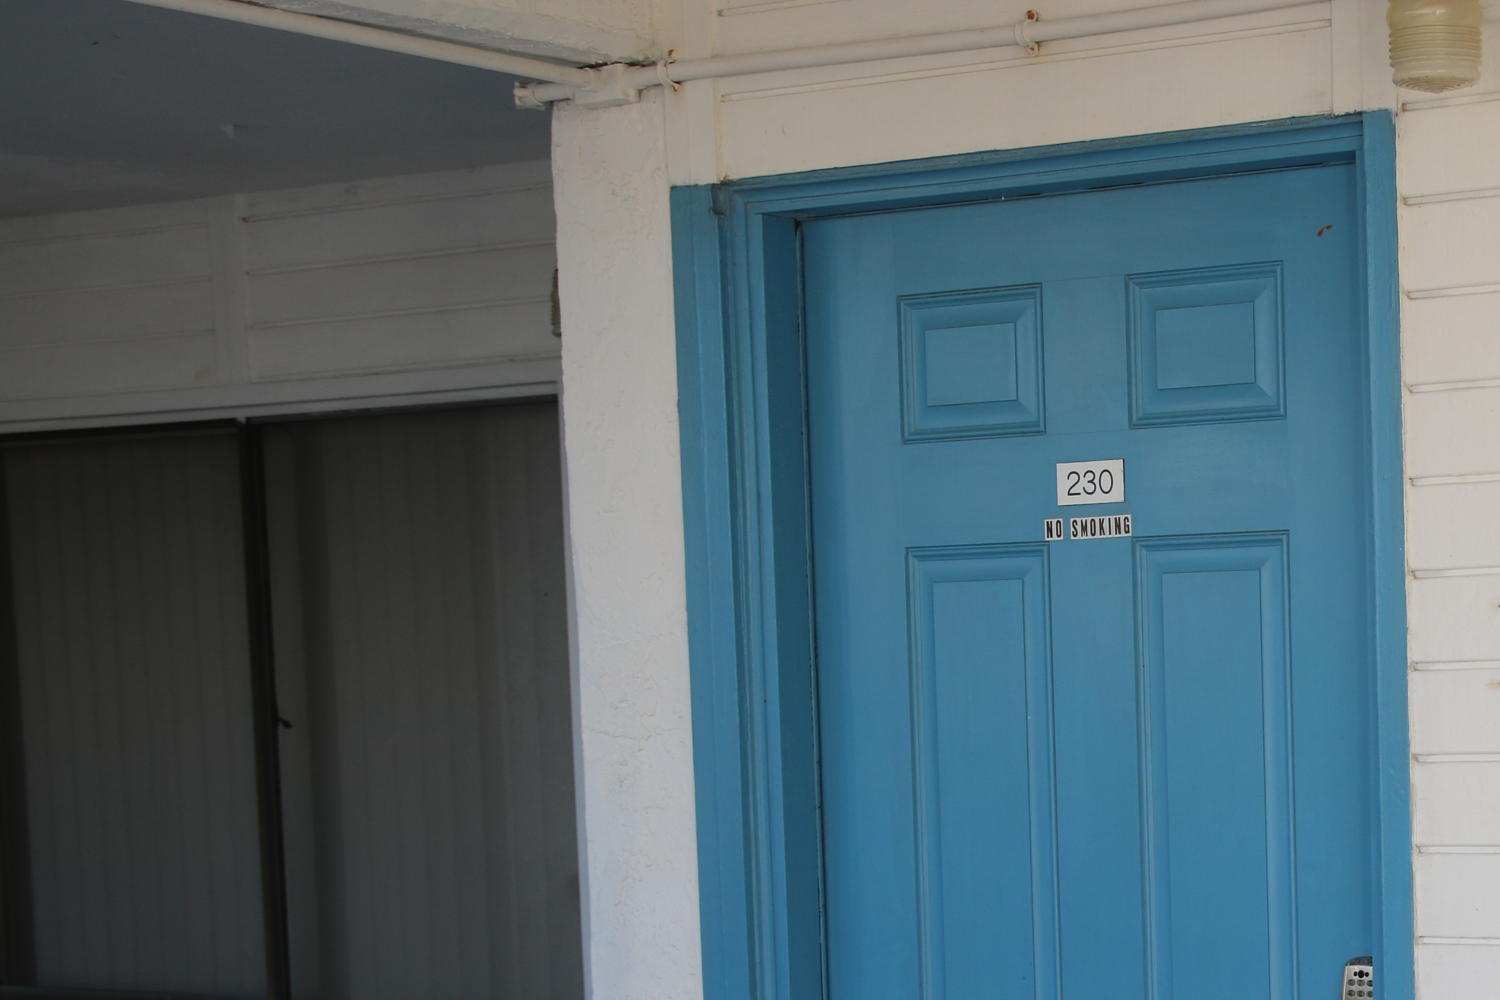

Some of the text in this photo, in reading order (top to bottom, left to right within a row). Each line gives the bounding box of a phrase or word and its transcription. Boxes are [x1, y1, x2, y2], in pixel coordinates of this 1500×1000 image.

[1067, 469, 1114, 496] 230
[1046, 516, 1130, 539] NO SMOKING
